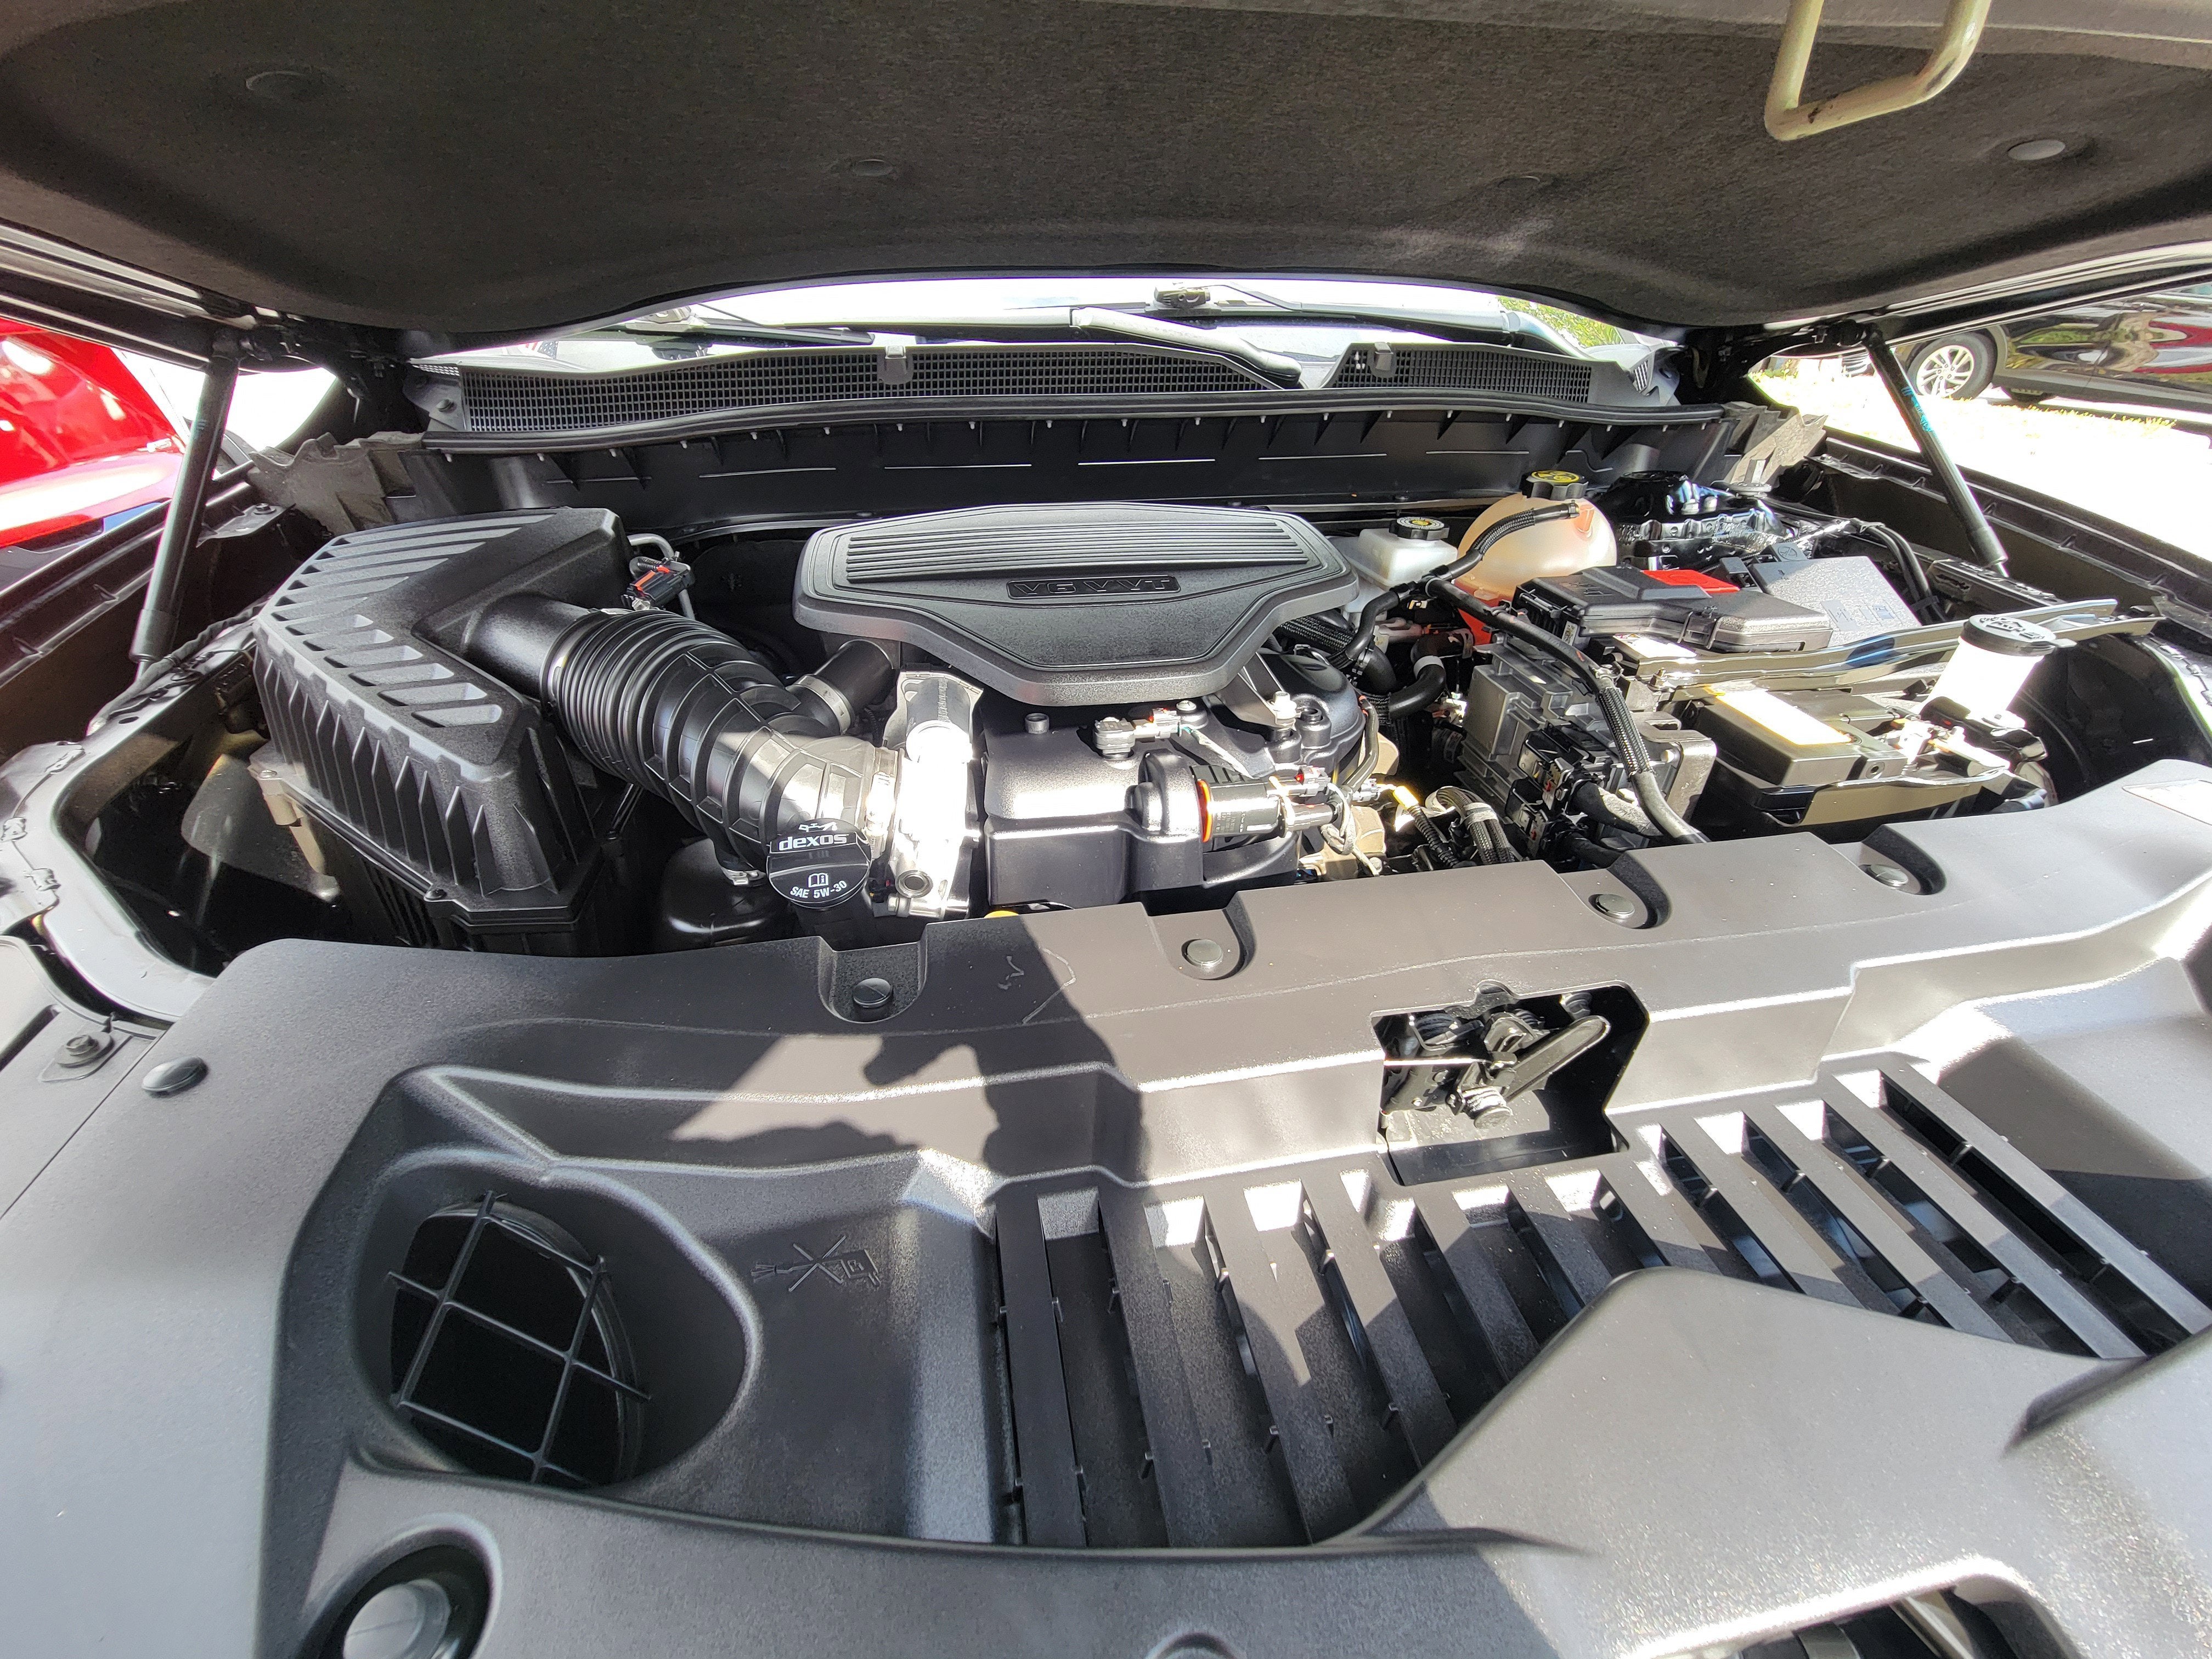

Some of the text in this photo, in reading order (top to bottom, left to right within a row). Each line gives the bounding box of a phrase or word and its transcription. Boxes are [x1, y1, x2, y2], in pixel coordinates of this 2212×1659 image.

[778, 834, 848, 851] dexos
[790, 880, 847, 899] SAE 5W-30
